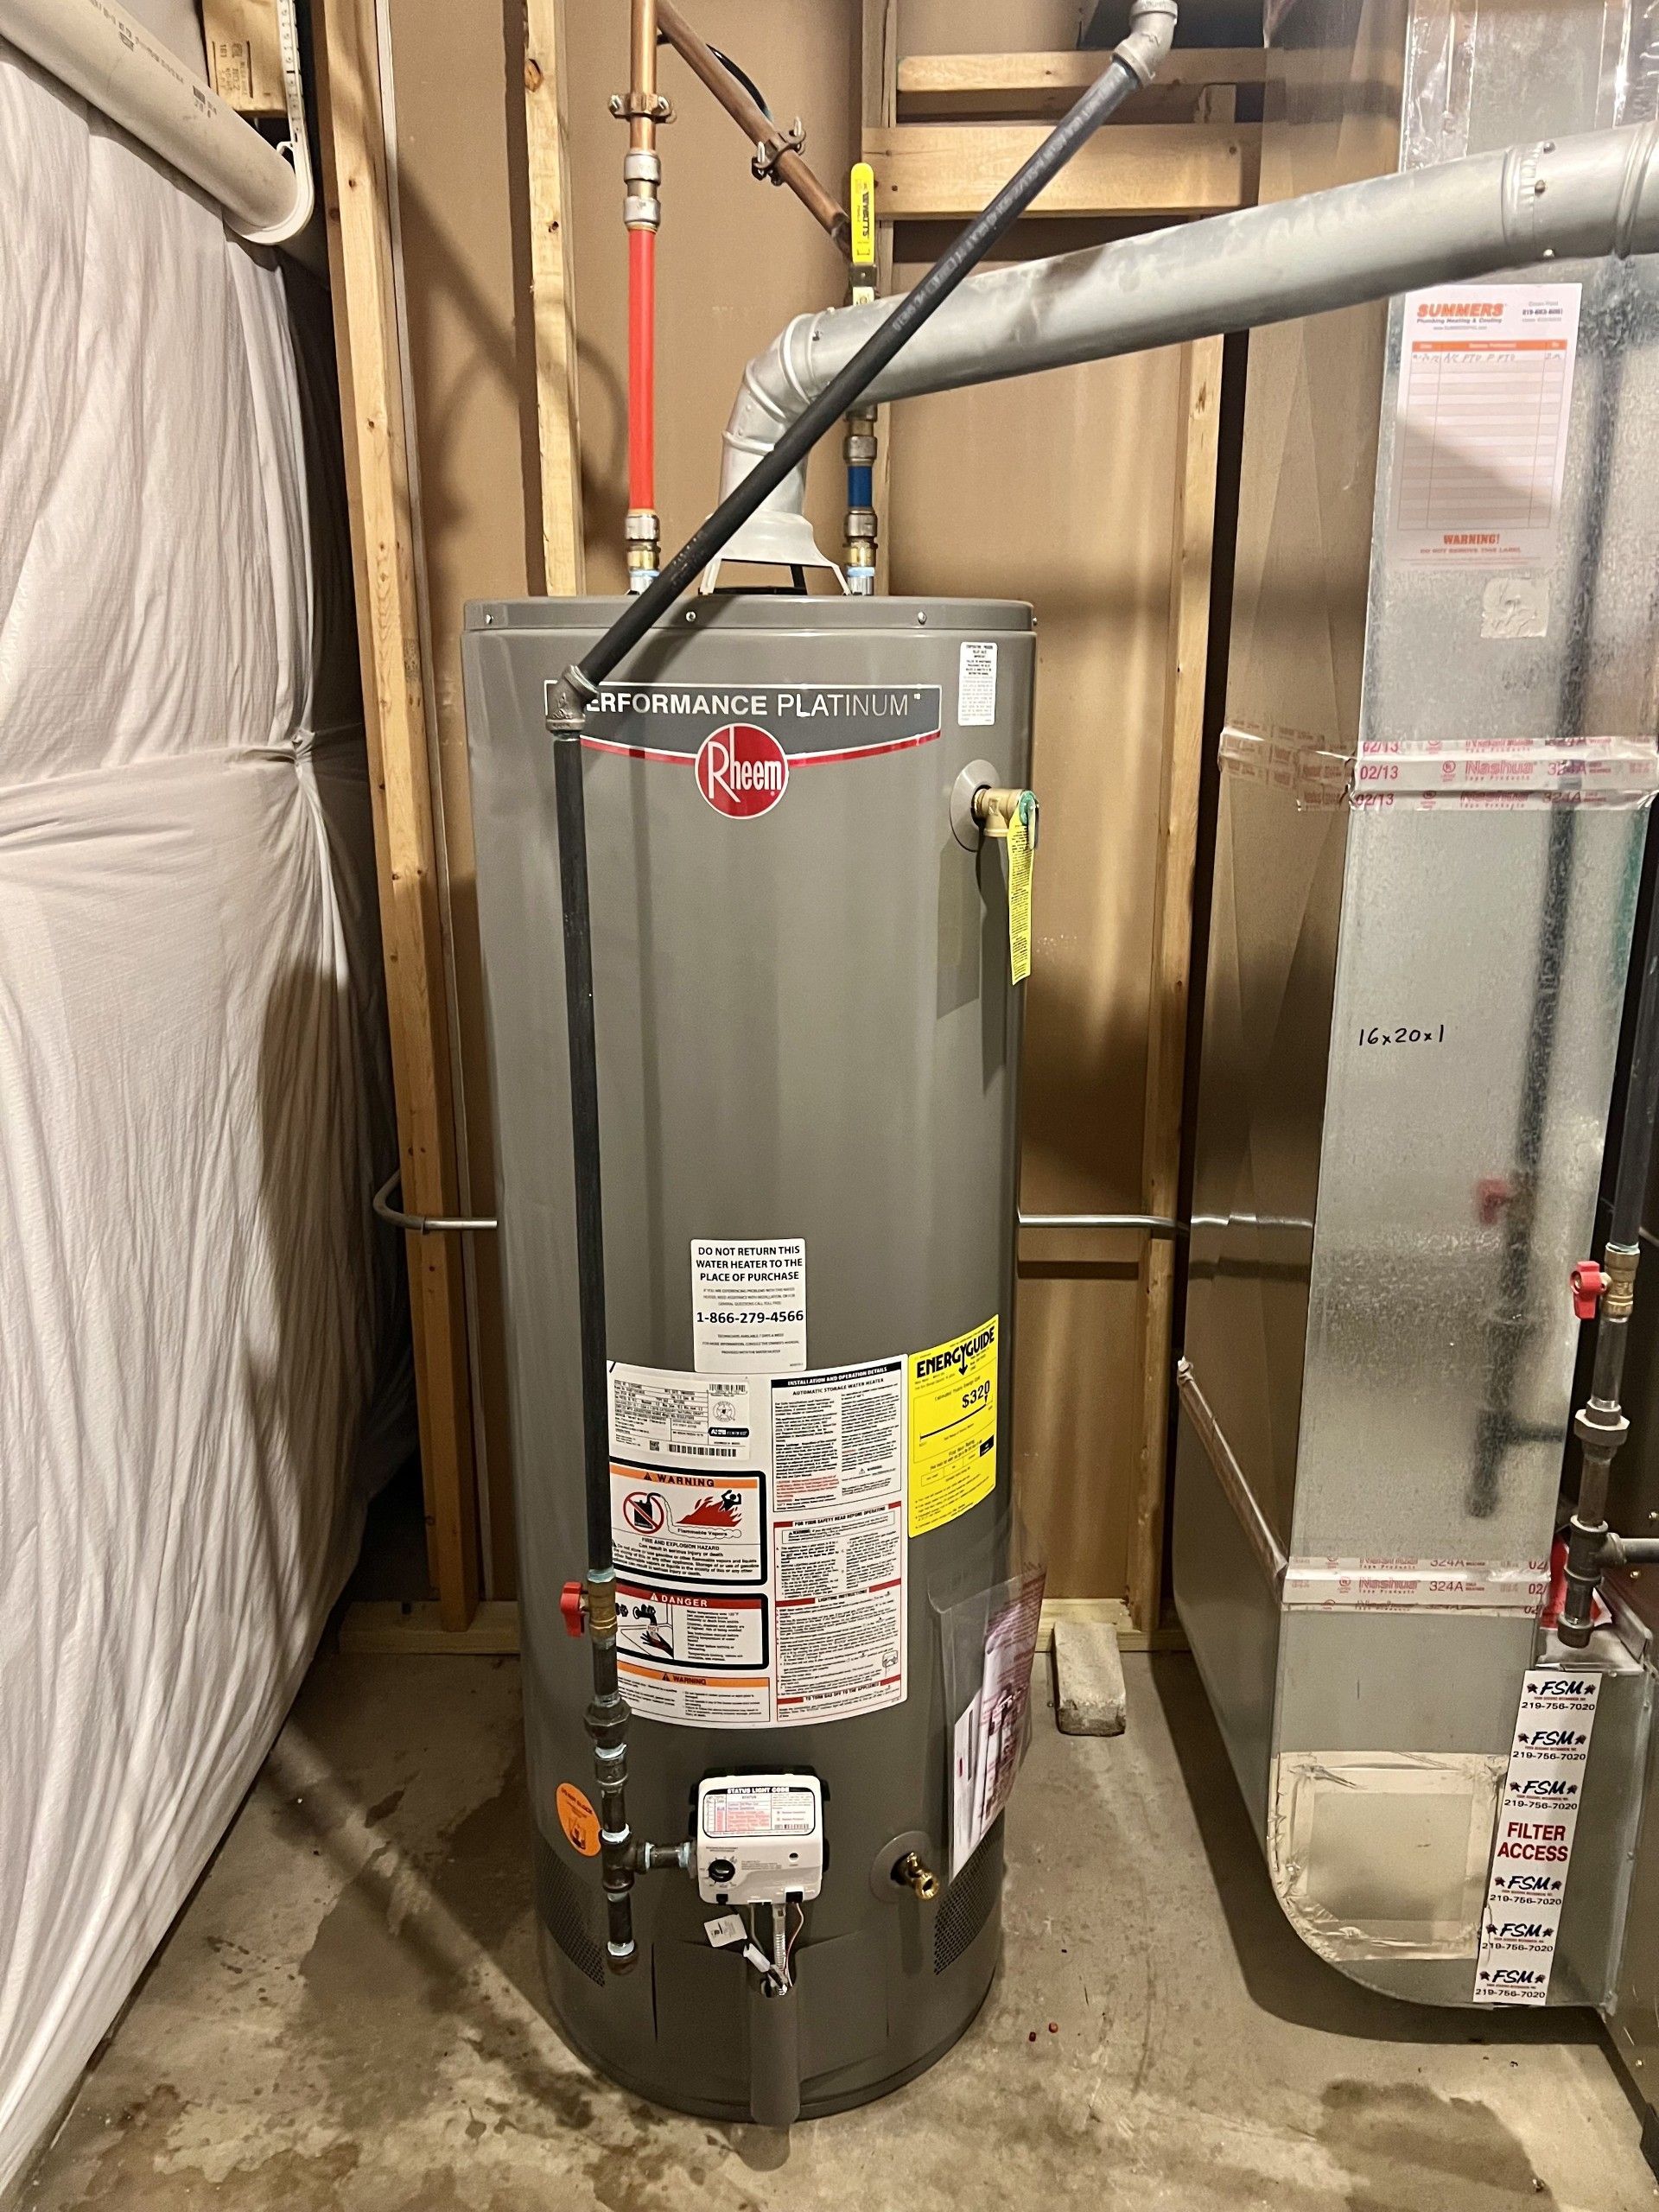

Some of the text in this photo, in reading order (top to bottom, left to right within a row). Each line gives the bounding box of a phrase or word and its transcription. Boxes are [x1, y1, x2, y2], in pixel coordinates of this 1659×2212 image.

[1417, 302, 1504, 317] SUMMERS
[1443, 533, 1500, 544] WARNING!
[586, 692, 908, 717] ERFORMANCE PLATINUM
[708, 726, 782, 804] Rheem
[1360, 766, 1399, 779] 02/13
[1465, 760, 1534, 775] Nashua
[1354, 793, 1395, 805] 02/13
[1359, 1024, 1445, 1046] 16x20x1
[698, 1245, 800, 1256] DO NOT RETURN THIS
[696, 1258, 803, 1269] WATER HEATER TO THE
[700, 1271, 800, 1282] PLACE OF PURCHASE
[696, 1310, 804, 1324] 1-866-279-4566
[787, 1377, 825, 1386] INSTALLATION
[838, 1370, 867, 1380] OPERATION
[867, 1366, 887, 1376] DETAILS
[962, 1380, 990, 1408] $320
[657, 1473, 715, 1488] WARNING
[666, 1541, 696, 1549] EXPLOSION
[1358, 1580, 1419, 1590] Nashua
[1429, 1580, 1464, 1592] 324A
[661, 1594, 708, 1607] DANGER
[672, 1675, 707, 1686] WARNING
[1539, 1681, 1584, 1695] FSM
[1521, 1702, 1595, 1711] 219-756-7020
[1530, 1731, 1575, 1745] FSM
[1512, 1751, 1586, 1760] 219-756-7020
[1522, 1780, 1567, 1795] FSM
[1503, 1799, 1578, 1810] 219-756-7020
[1507, 1822, 1567, 1841] FILTER
[1497, 1841, 1569, 1862] ACCESS
[1507, 1876, 1552, 1891] FSM
[1489, 1894, 1562, 1905] 219-756-7020
[1499, 1923, 1543, 1937] FSM
[1491, 1969, 1535, 1984] FSM
[1475, 1988, 1546, 1999] 219-756-7020
